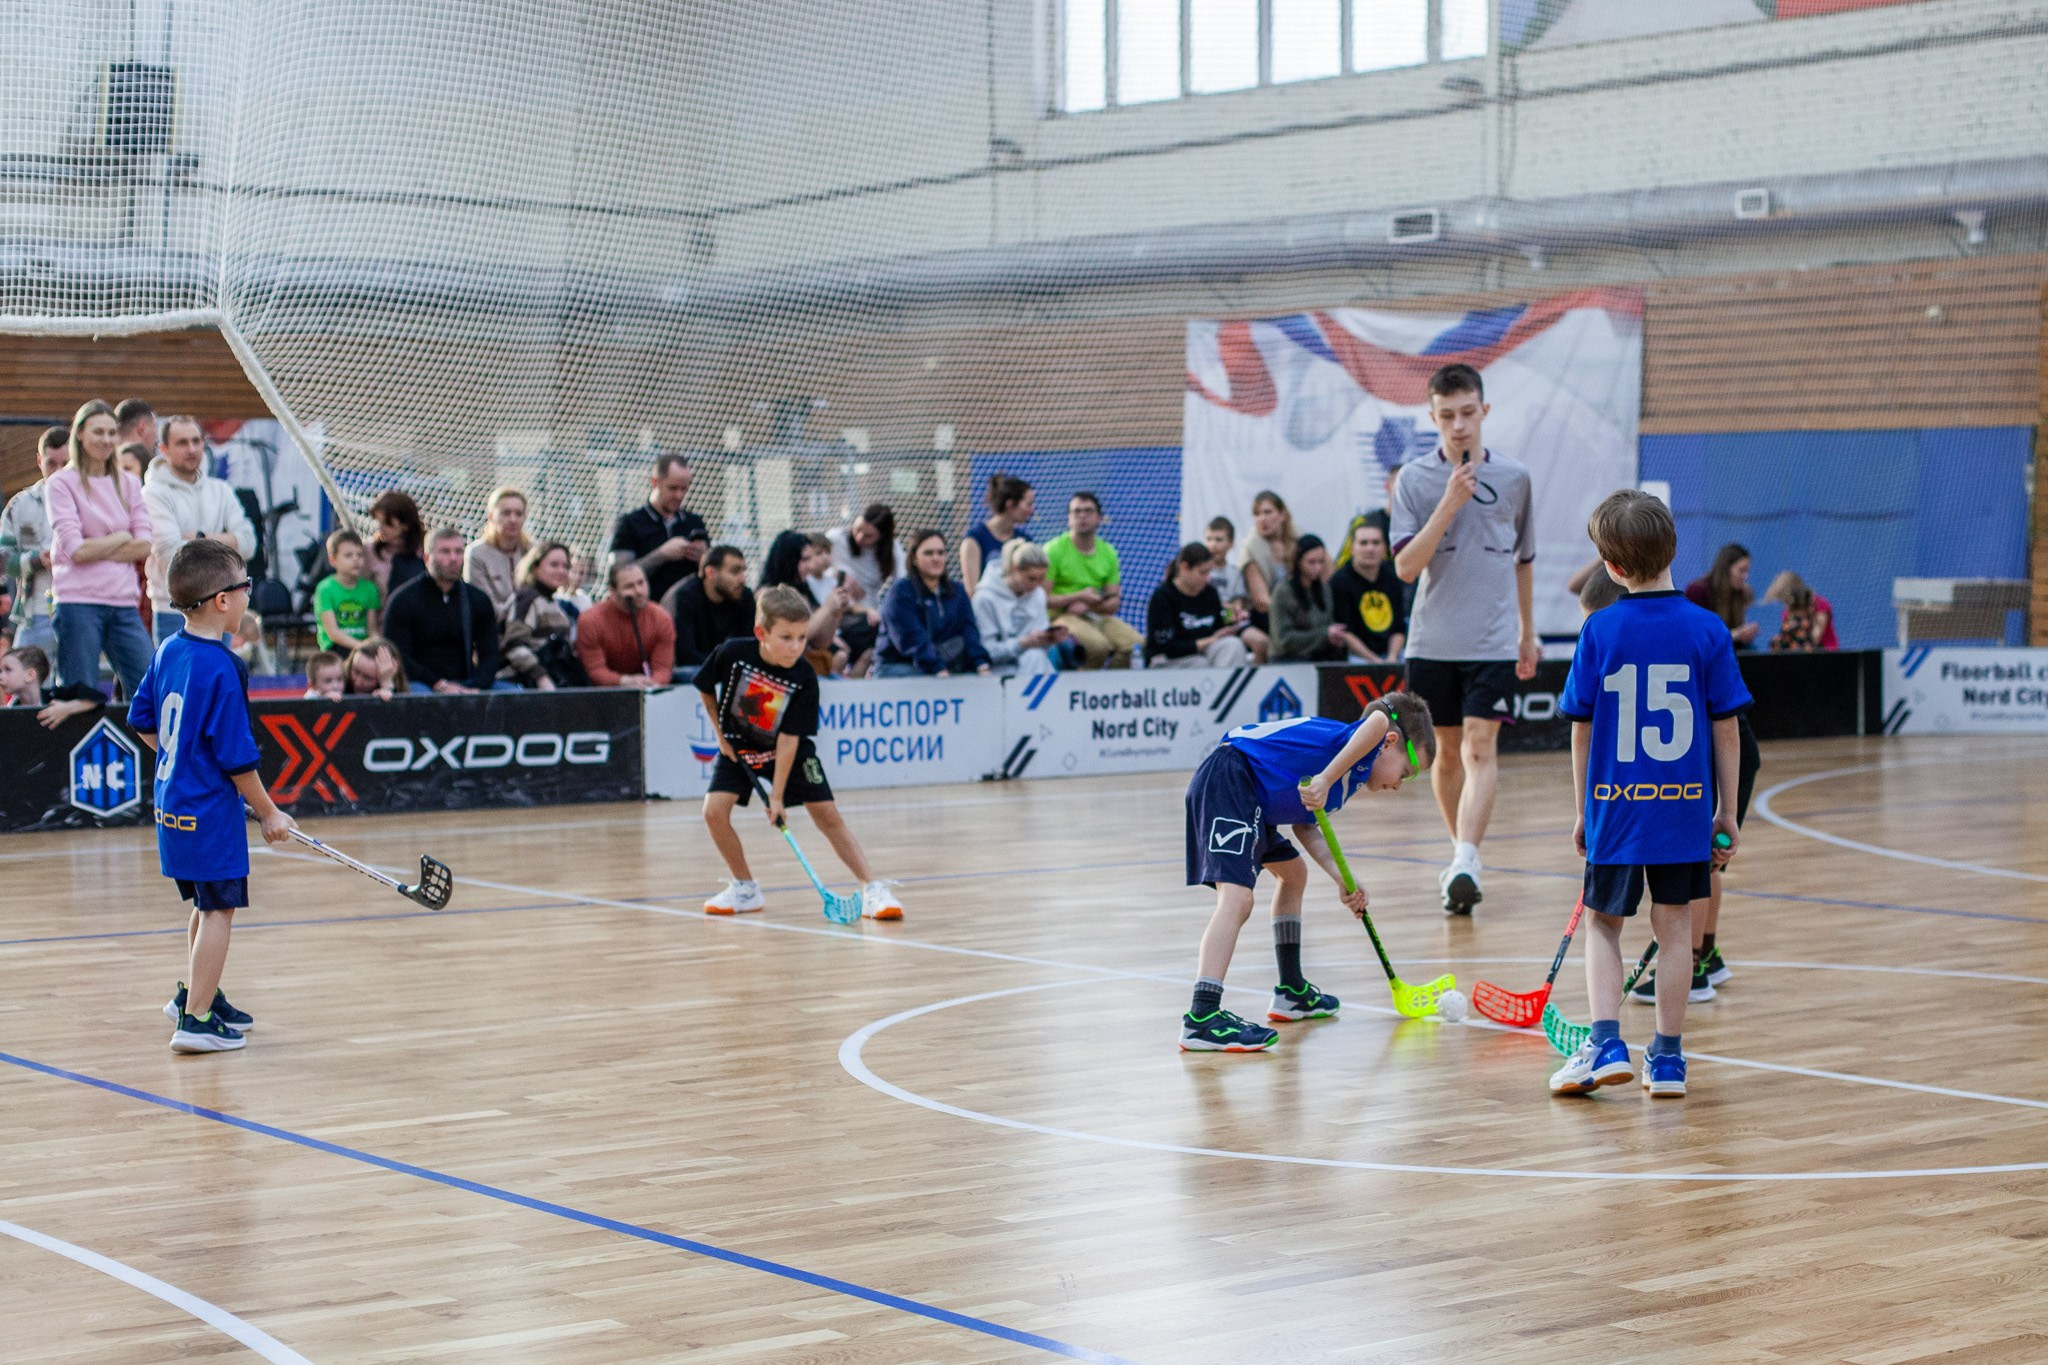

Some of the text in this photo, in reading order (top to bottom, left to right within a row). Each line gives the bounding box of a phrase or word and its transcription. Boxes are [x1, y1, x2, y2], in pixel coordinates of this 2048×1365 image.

[1069, 687, 1201, 711] Floorball club
[2015, 686, 2048, 709] Cit
[818, 699, 964, 731] МИНСПОРТ
[1603, 664, 1694, 763] 15
[156, 692, 184, 781] 9
[1092, 718, 1179, 740] Nord City
[363, 731, 612, 772] OXDOG
[837, 735, 943, 765] РОССИИ
[81, 761, 126, 790] NC
[1594, 782, 1703, 801] OXDOG
[153, 807, 197, 831] DOG
